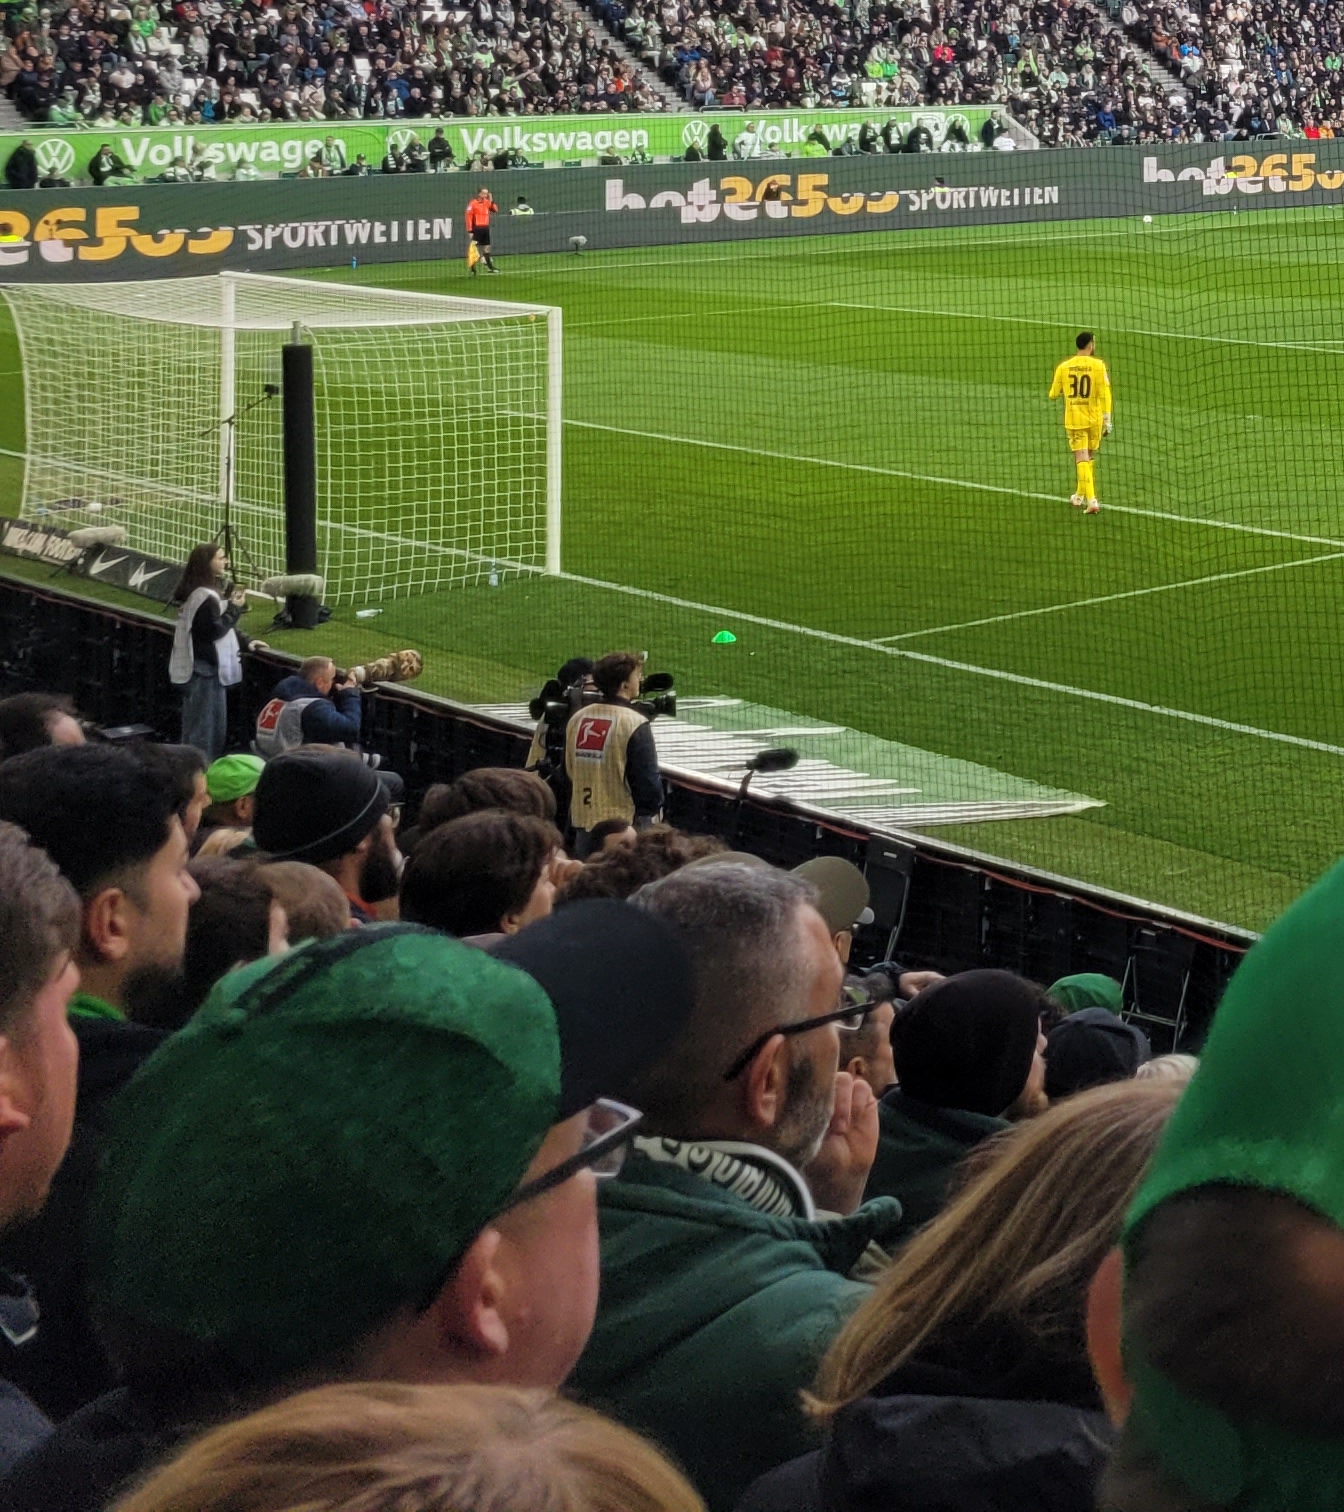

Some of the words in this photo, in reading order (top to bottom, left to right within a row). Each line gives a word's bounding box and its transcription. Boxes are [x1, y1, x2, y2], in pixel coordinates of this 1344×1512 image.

[121, 136, 346, 169] Volswagen
[460, 126, 649, 156] Volkswagen
[1068, 374, 1092, 399] 30
